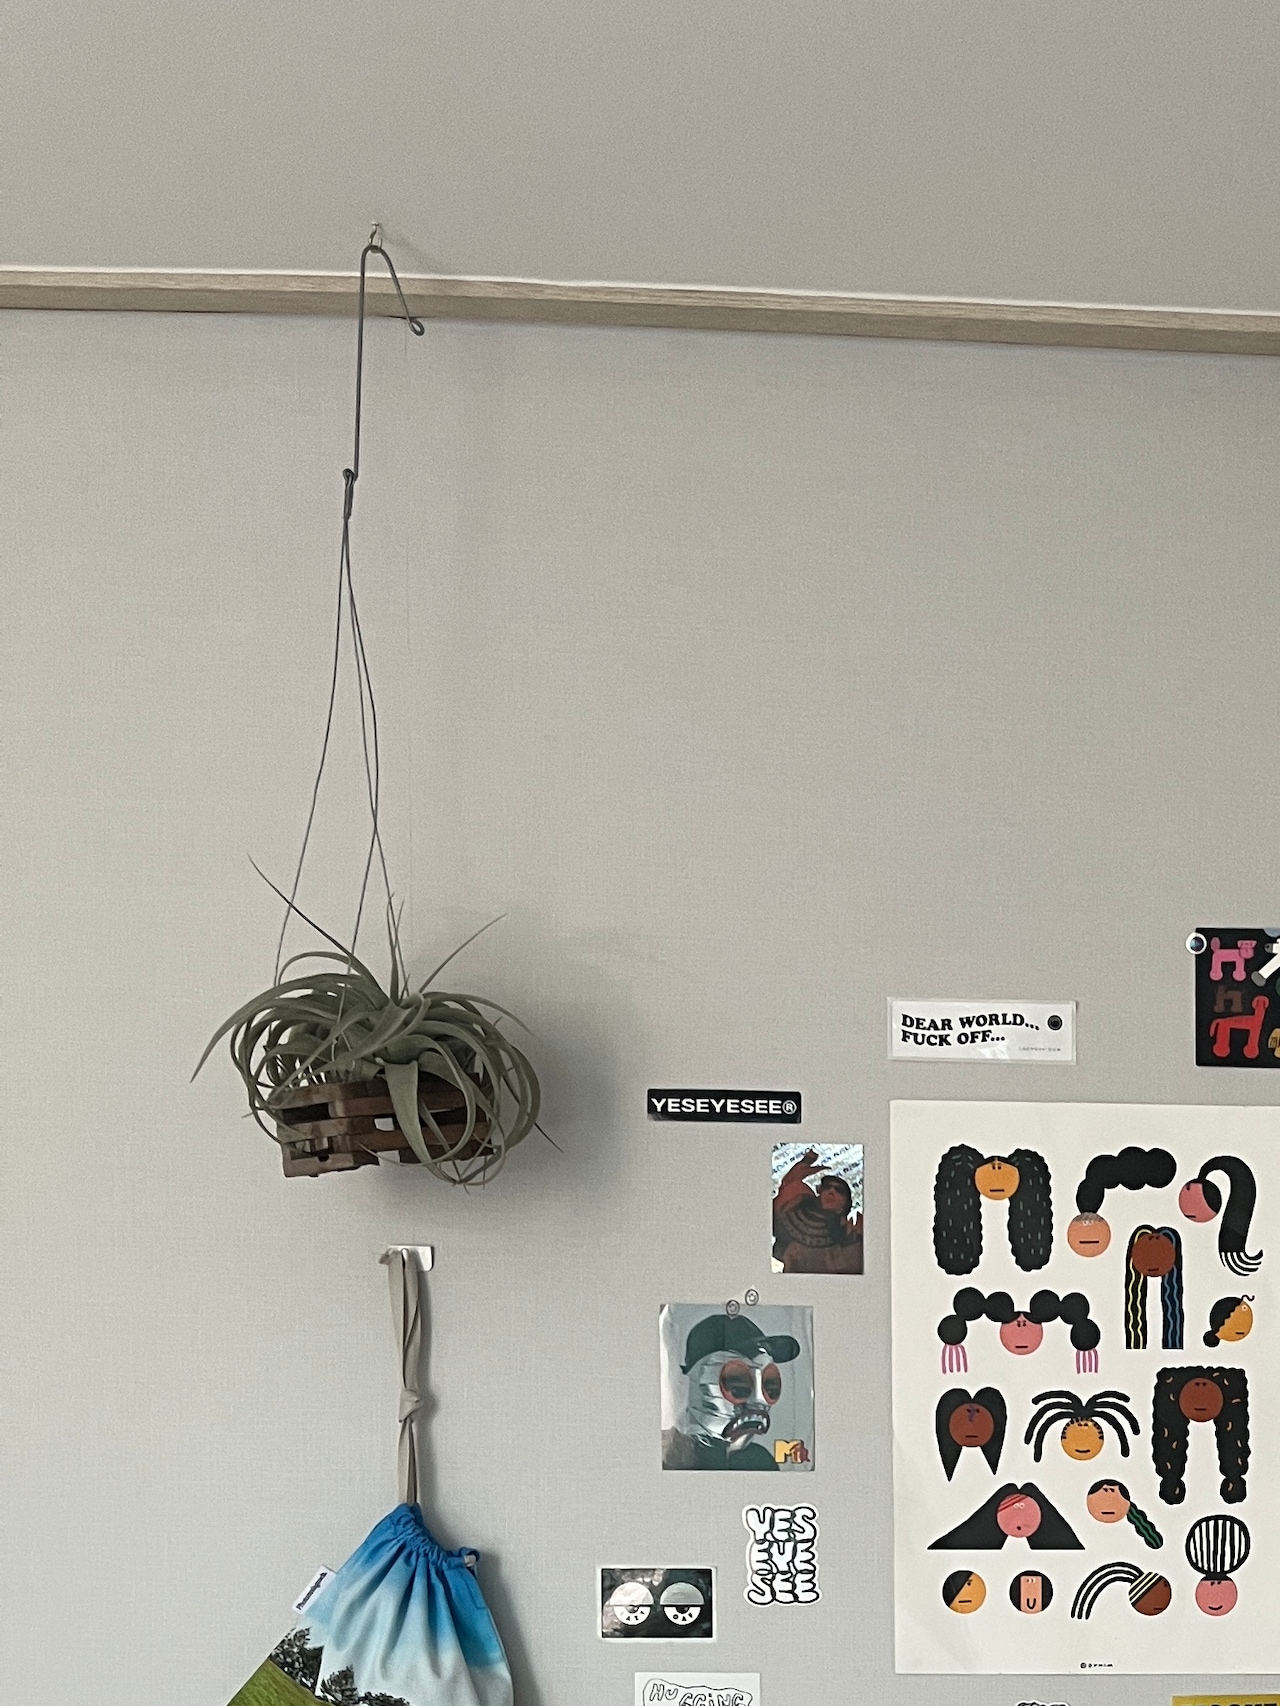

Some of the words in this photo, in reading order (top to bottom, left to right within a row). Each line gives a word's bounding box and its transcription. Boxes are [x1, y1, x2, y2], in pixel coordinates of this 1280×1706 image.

[901, 1013, 953, 1031] DEAR
[958, 1013, 1040, 1031] WORLD...
[901, 1029, 952, 1046] FUCK
[957, 1029, 1005, 1045] OFF...
[746, 1506, 817, 1543] YES
[749, 1540, 816, 1577] EYE
[747, 1571, 820, 1605] SEE
